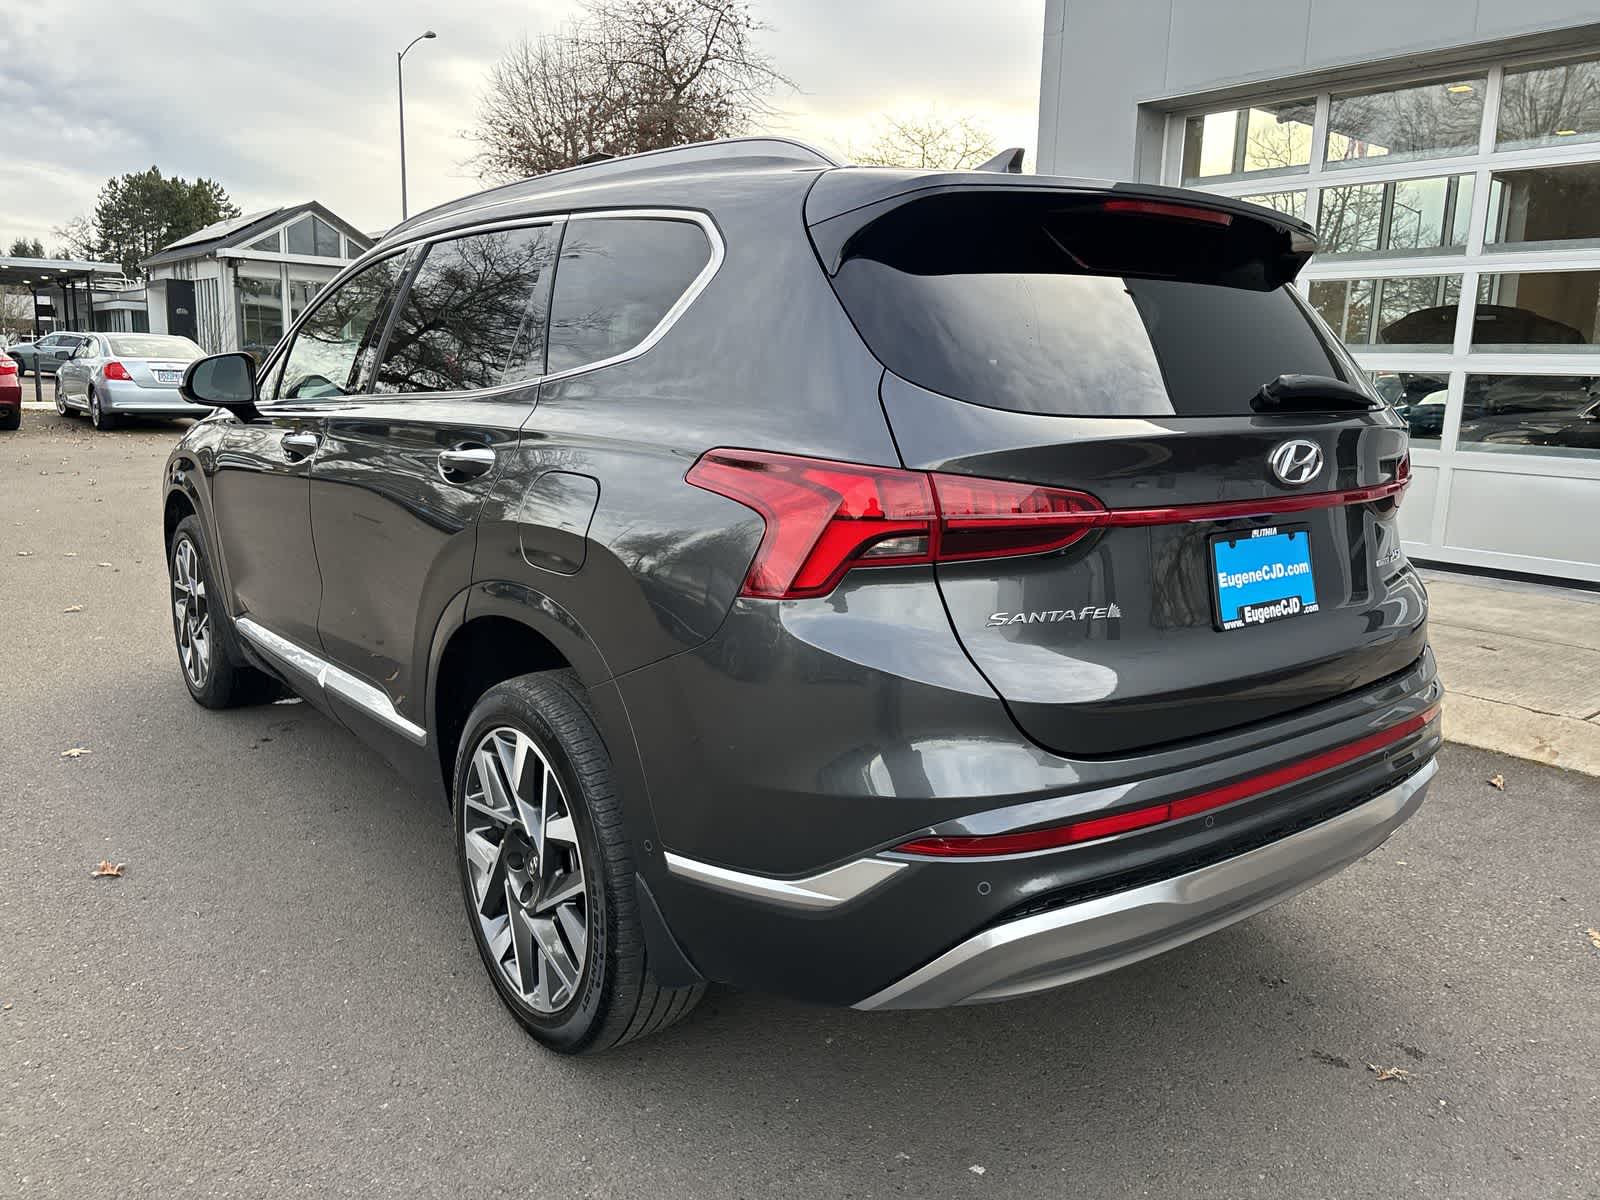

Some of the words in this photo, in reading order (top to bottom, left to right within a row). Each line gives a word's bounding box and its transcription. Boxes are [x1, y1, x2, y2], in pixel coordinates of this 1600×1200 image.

[1218, 562, 1310, 588] EugeneCJD.com
[1223, 620, 1245, 630] www.
[1244, 597, 1300, 623] EugeneCJD
